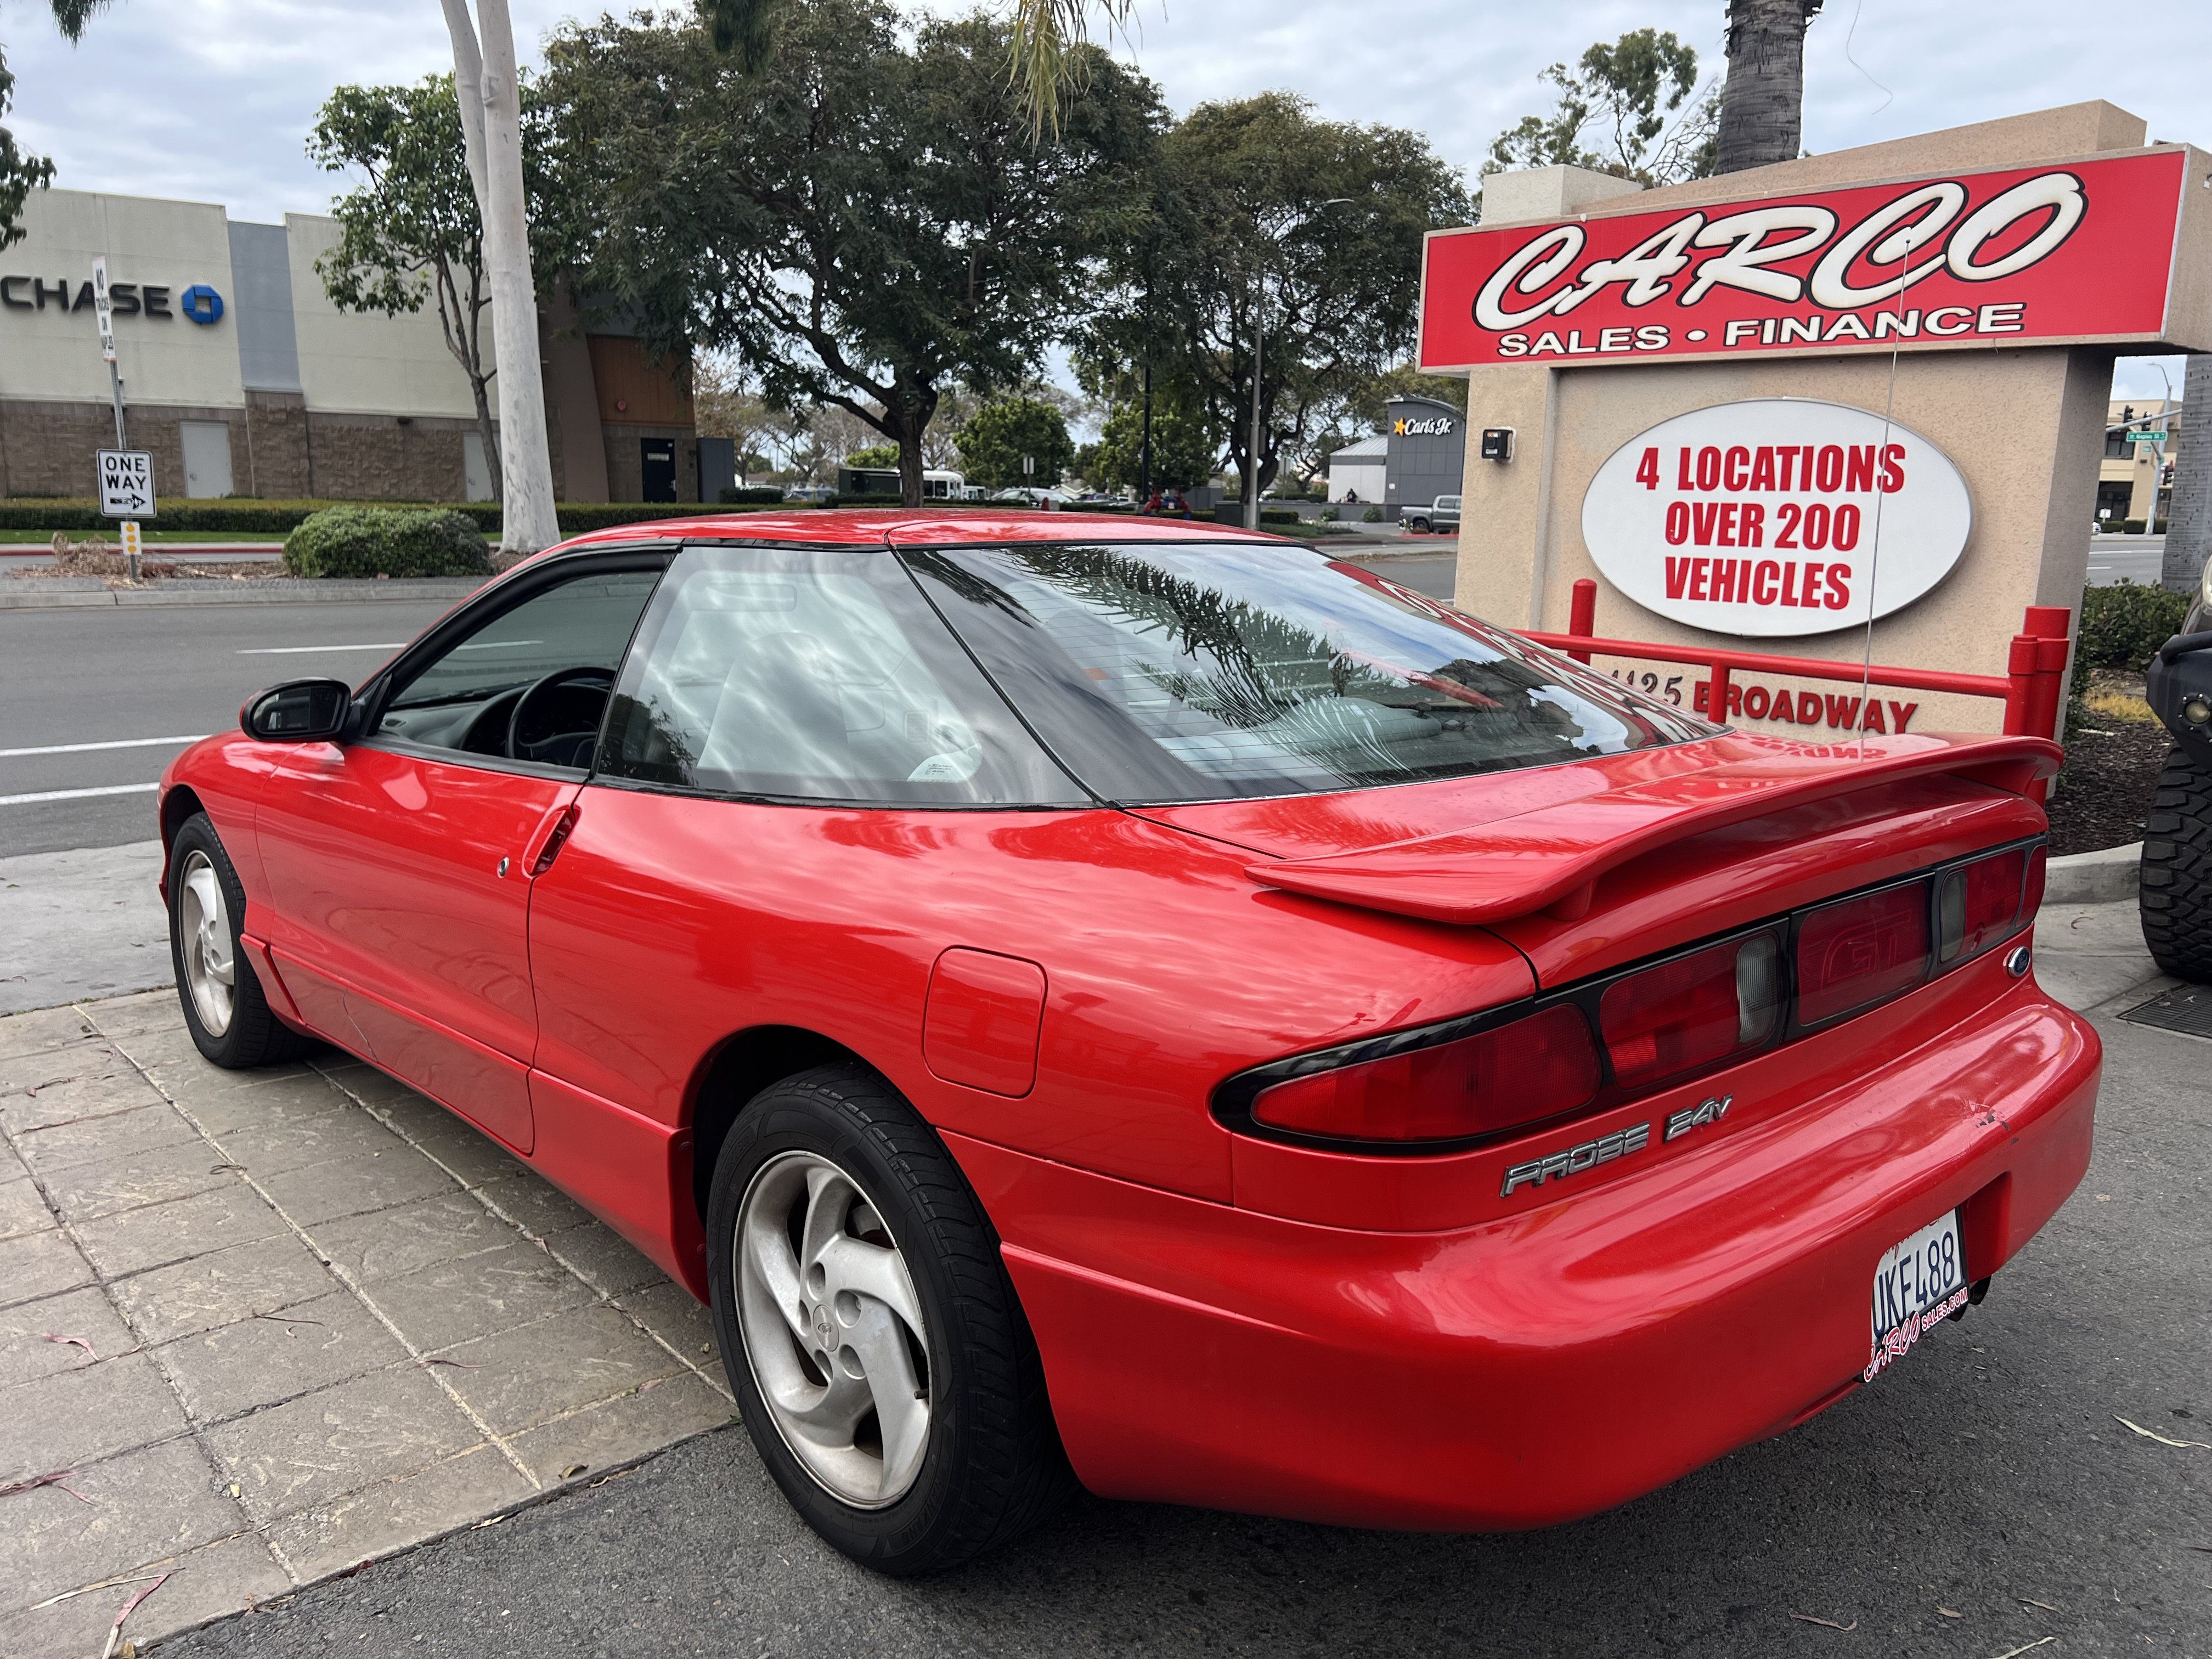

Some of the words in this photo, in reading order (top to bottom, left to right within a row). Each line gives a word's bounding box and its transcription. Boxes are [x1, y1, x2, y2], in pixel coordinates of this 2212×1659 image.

[1473, 172, 2086, 330] CARCO
[0, 275, 173, 317] CHASE
[1498, 325, 1669, 357] SALES
[1724, 303, 2027, 347] FINANCE
[1404, 417, 1436, 436] Carl's
[1435, 417, 1452, 436] Jr.
[105, 474, 146, 490] WAY
[106, 455, 145, 472] ONE
[1635, 447, 1660, 490] 4
[1677, 444, 1906, 493] LOCATIONS
[1664, 501, 1765, 548] OVER
[1774, 503, 1861, 551] 200
[1664, 556, 1852, 611] VEHICLES
[1693, 680, 1918, 734] BROADWAY
[1499, 1120, 1650, 1198] PROBE
[1864, 1312, 1920, 1383] CARCO
[1921, 1286, 1968, 1331] SALES.COM
